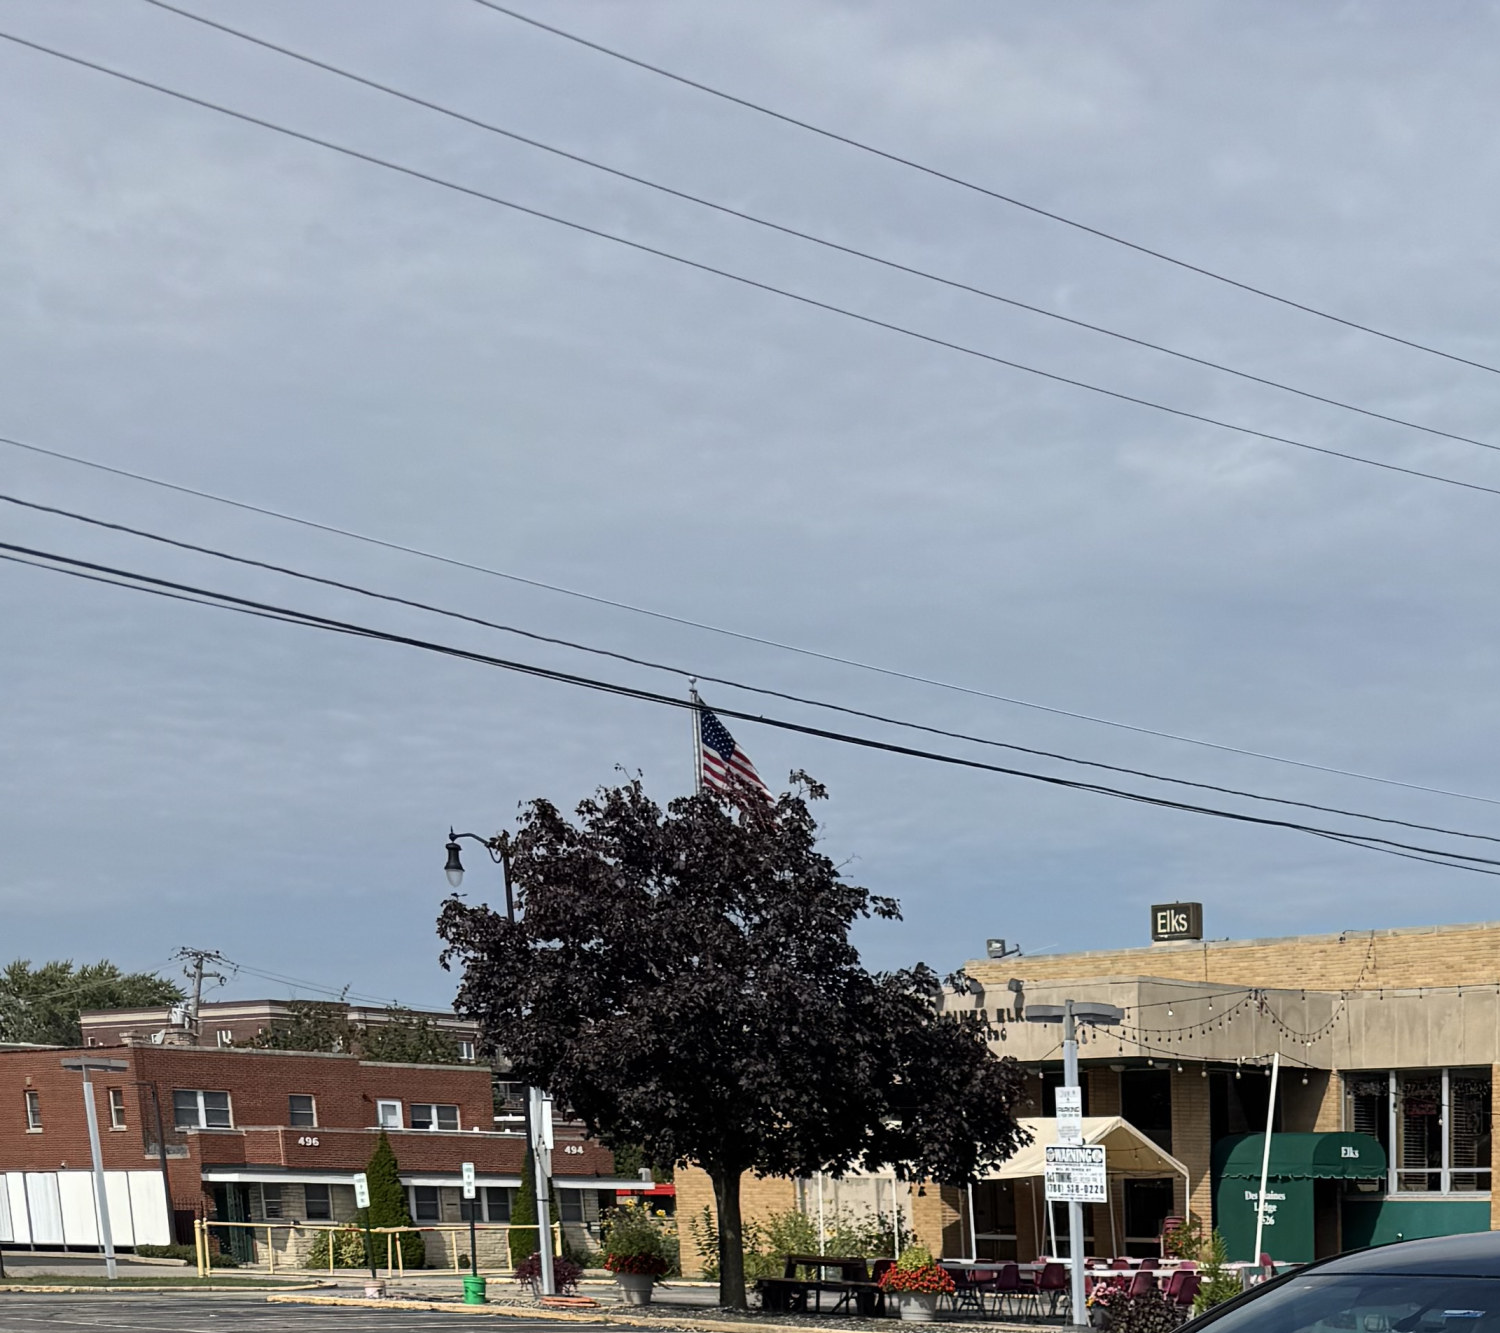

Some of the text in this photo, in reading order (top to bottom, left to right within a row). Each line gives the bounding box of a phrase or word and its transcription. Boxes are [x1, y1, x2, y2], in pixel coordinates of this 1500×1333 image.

[1157, 909, 1188, 933] Elks
[996, 1008, 1026, 1023] ELK
[298, 1136, 320, 1146] 496
[564, 1145, 585, 1155] 494
[1054, 1148, 1093, 1163] WARNING
[1341, 1146, 1360, 1158] Elks
[1244, 1190, 1258, 1200] Des
[1253, 1201, 1277, 1214] Ldge
